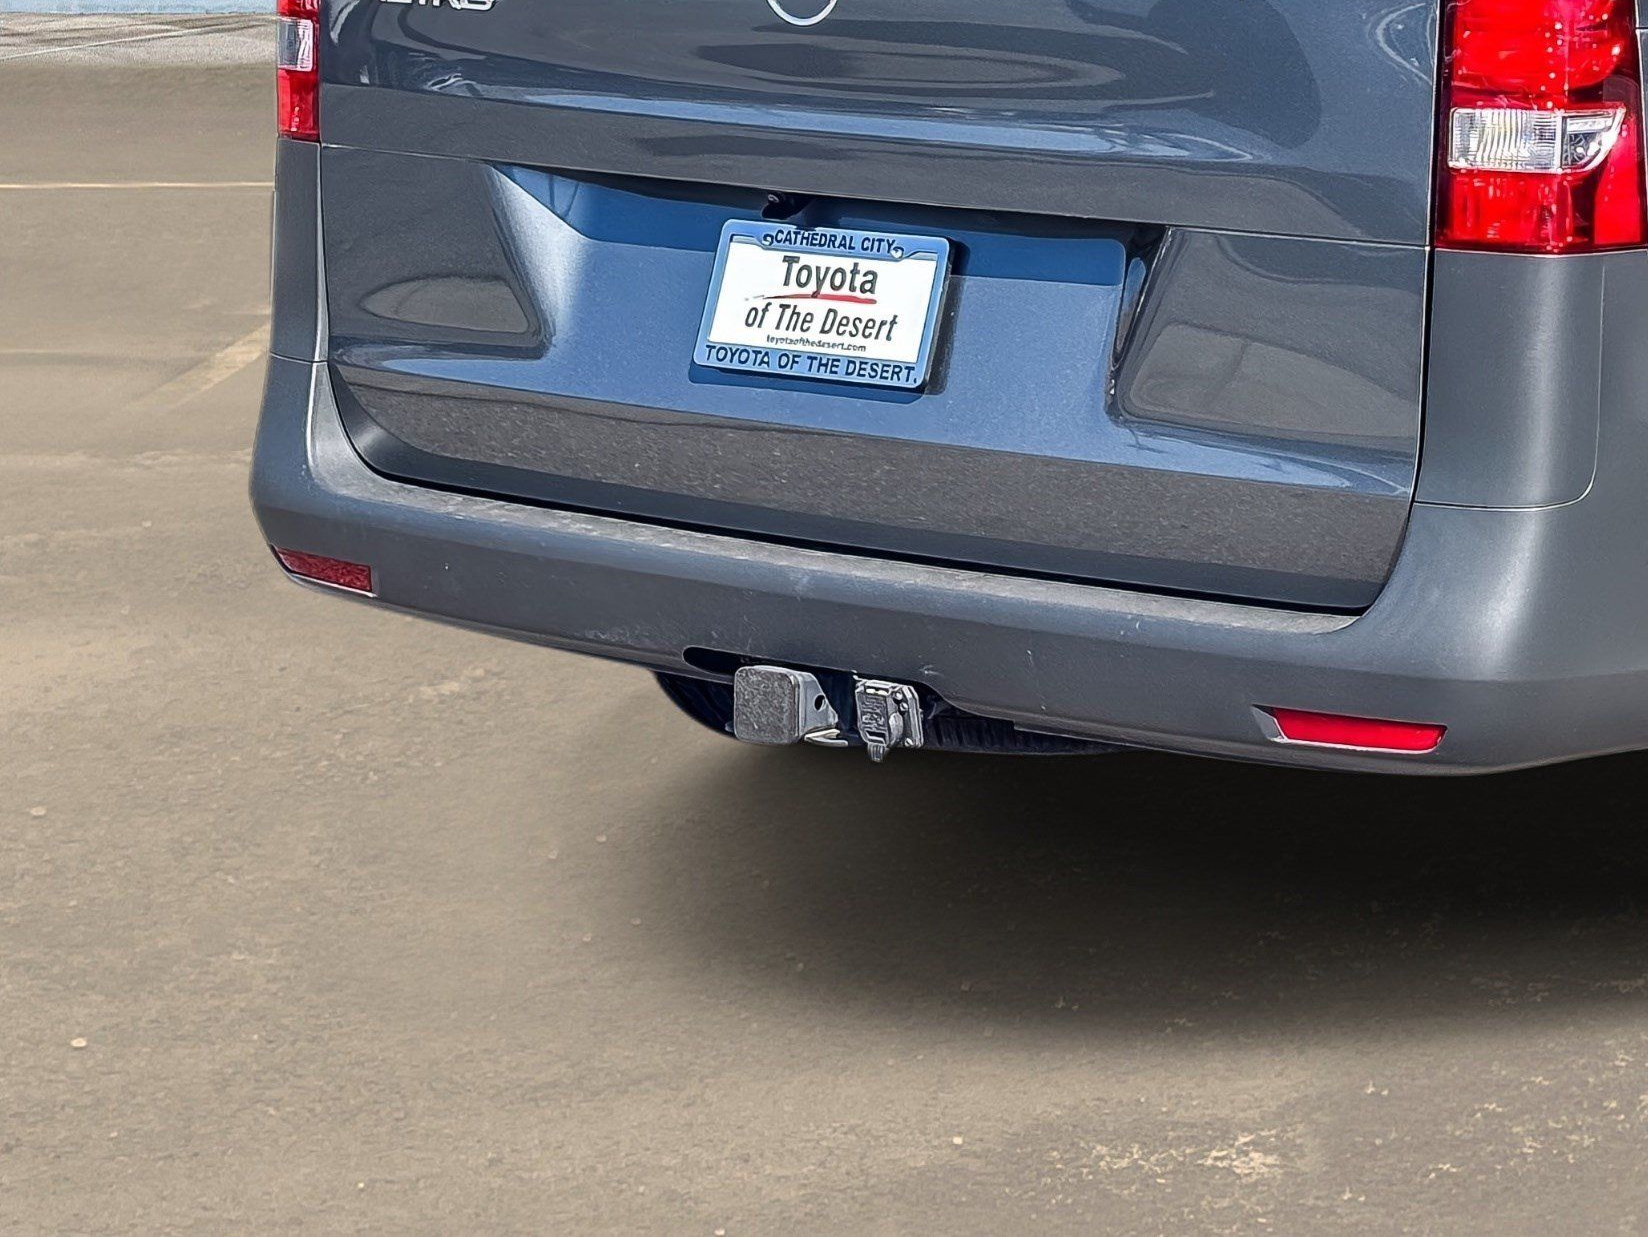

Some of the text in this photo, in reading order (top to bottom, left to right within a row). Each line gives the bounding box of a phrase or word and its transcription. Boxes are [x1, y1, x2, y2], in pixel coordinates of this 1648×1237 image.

[774, 229, 895, 255] CATHEDRAL CITY
[782, 254, 879, 299] Toyota
[744, 302, 898, 342] of The Desert
[705, 344, 771, 368] TOYOTA
[777, 353, 800, 371] OF
[806, 355, 839, 375] THE
